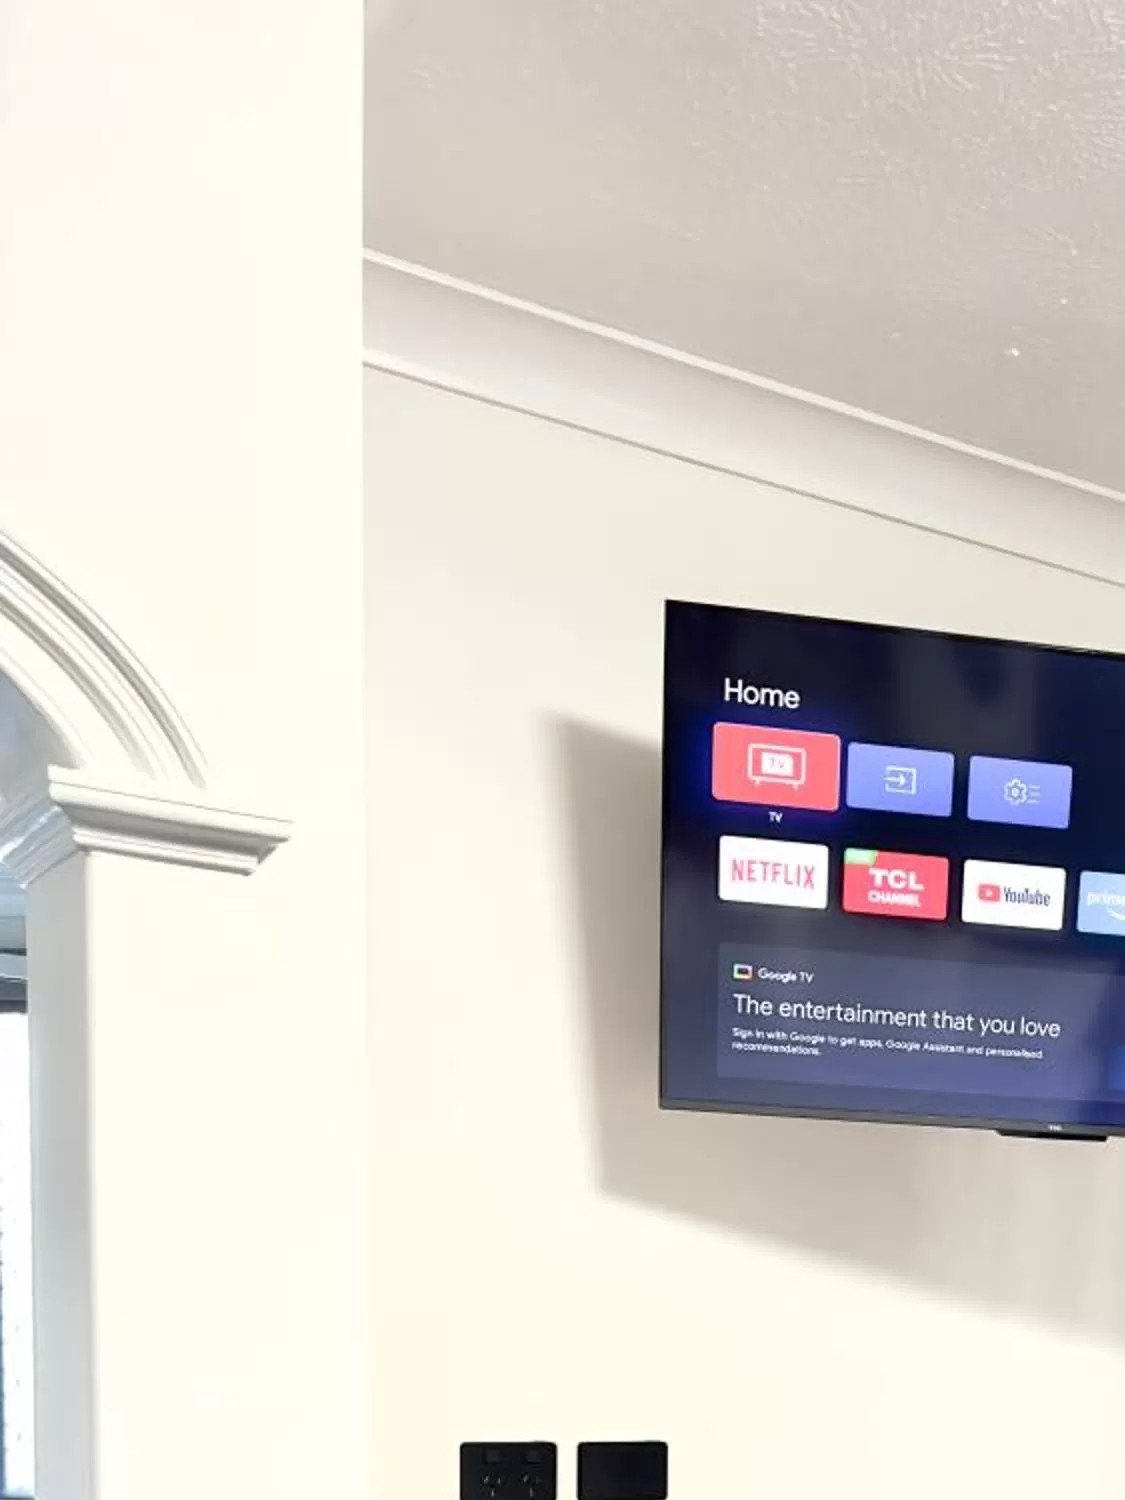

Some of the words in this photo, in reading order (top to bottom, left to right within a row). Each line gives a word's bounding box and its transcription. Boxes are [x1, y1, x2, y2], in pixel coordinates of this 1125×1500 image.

[724, 677, 800, 708] Home
[768, 811, 783, 823] TV
[730, 858, 816, 890] NETFLIX
[868, 867, 925, 891] TCL
[868, 889, 922, 908] CHANNEL
[1003, 885, 1051, 907] YouTube
[757, 967, 797, 984] Google
[799, 971, 815, 984] TV
[732, 993, 774, 1016] The
[779, 1000, 927, 1029] entertainment
[931, 1009, 975, 1031] that
[979, 1017, 1015, 1037] you
[1020, 1015, 1061, 1038] love
[732, 1027, 754, 1040] Sign
[755, 1029, 765, 1039] in
[766, 1030, 788, 1041] with
[789, 1031, 826, 1045] Google
[827, 1035, 839, 1045] to
[840, 1036, 857, 1047] get
[885, 1039, 921, 1052] Google
[922, 1041, 965, 1054] Assistant
[966, 1044, 984, 1055] and
